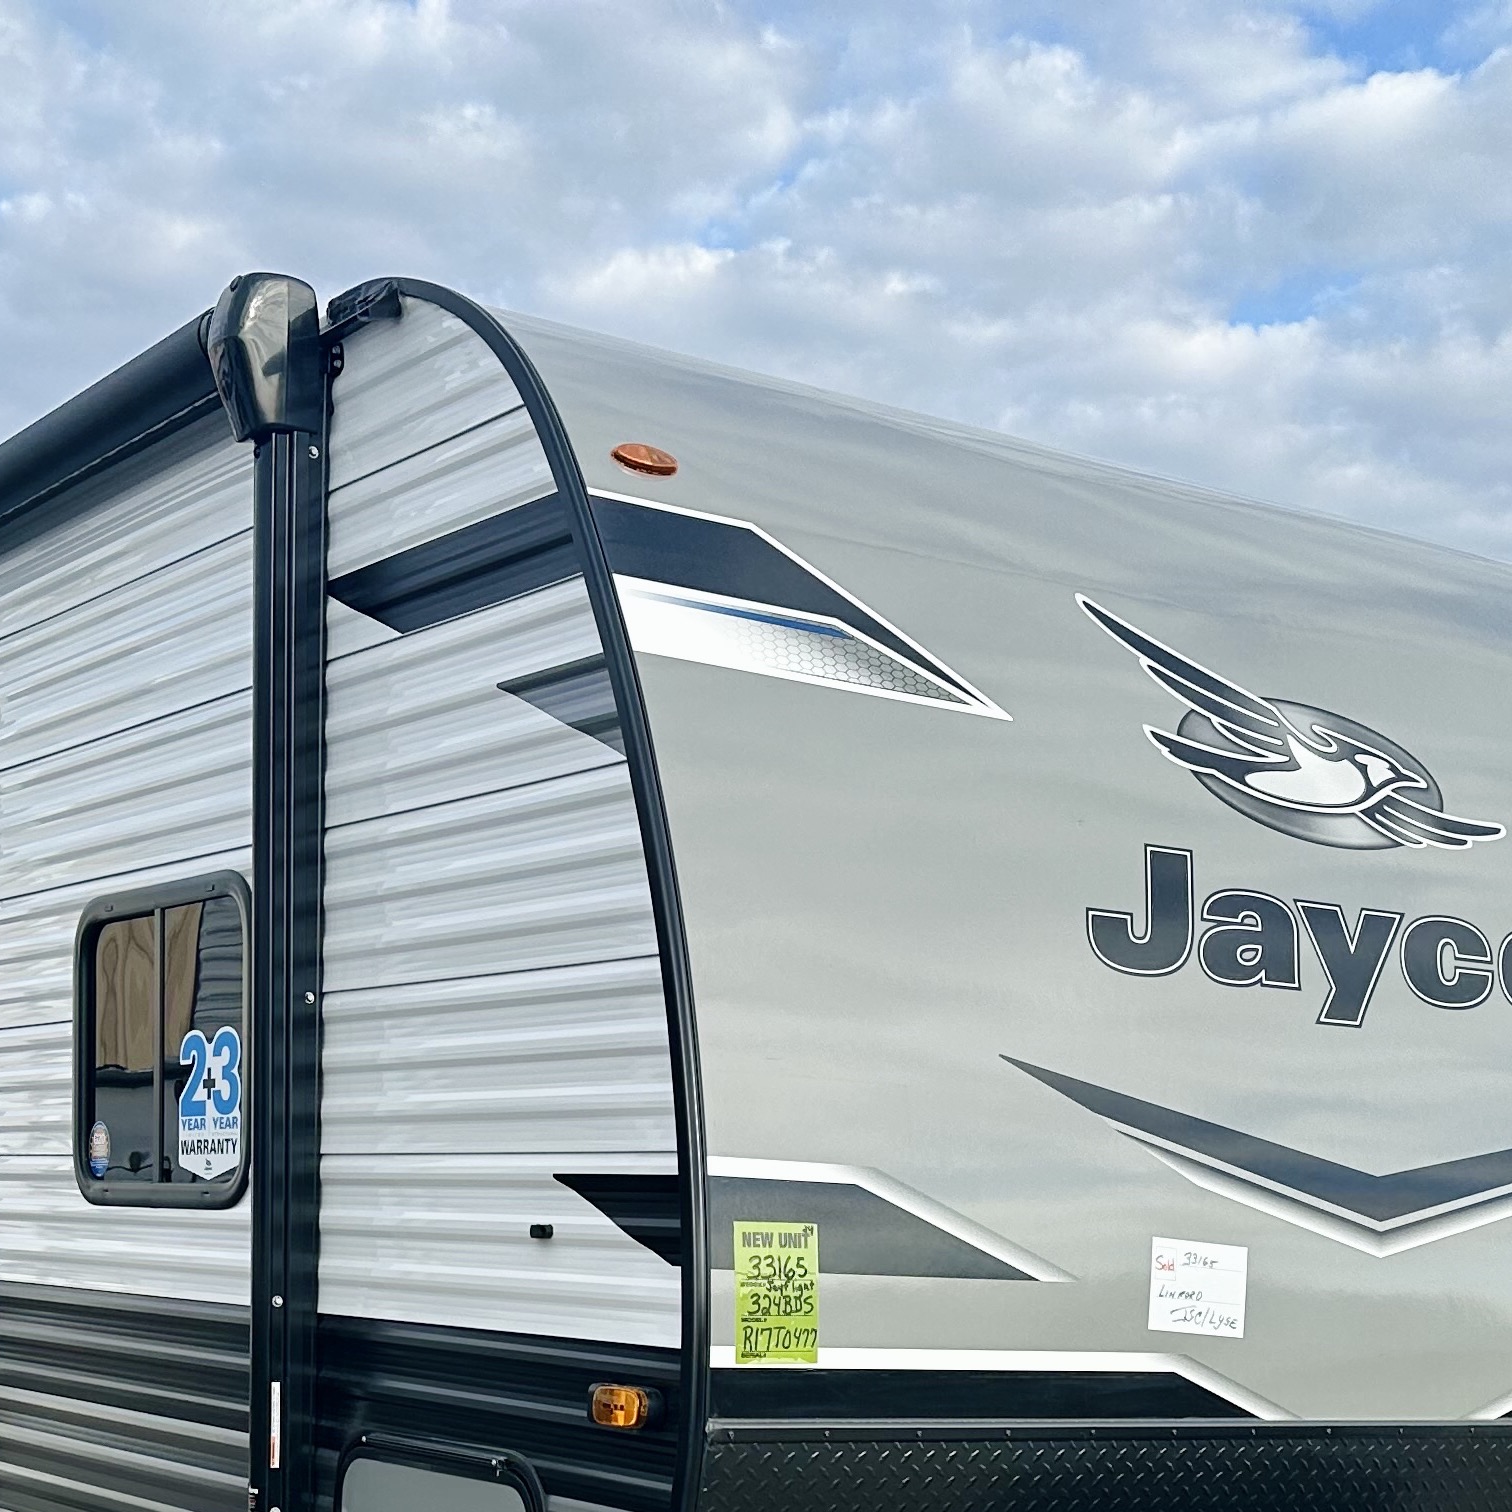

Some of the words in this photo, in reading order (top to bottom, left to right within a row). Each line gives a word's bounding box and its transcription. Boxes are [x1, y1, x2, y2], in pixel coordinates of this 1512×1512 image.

[181, 1118, 206, 1131] YEAR
[213, 1116, 238, 1130] YEAR
[181, 1138, 238, 1155] WARRANTY
[742, 1232, 774, 1248] NEW
[778, 1232, 810, 1249] UNIT
[747, 1255, 808, 1281] 33165
